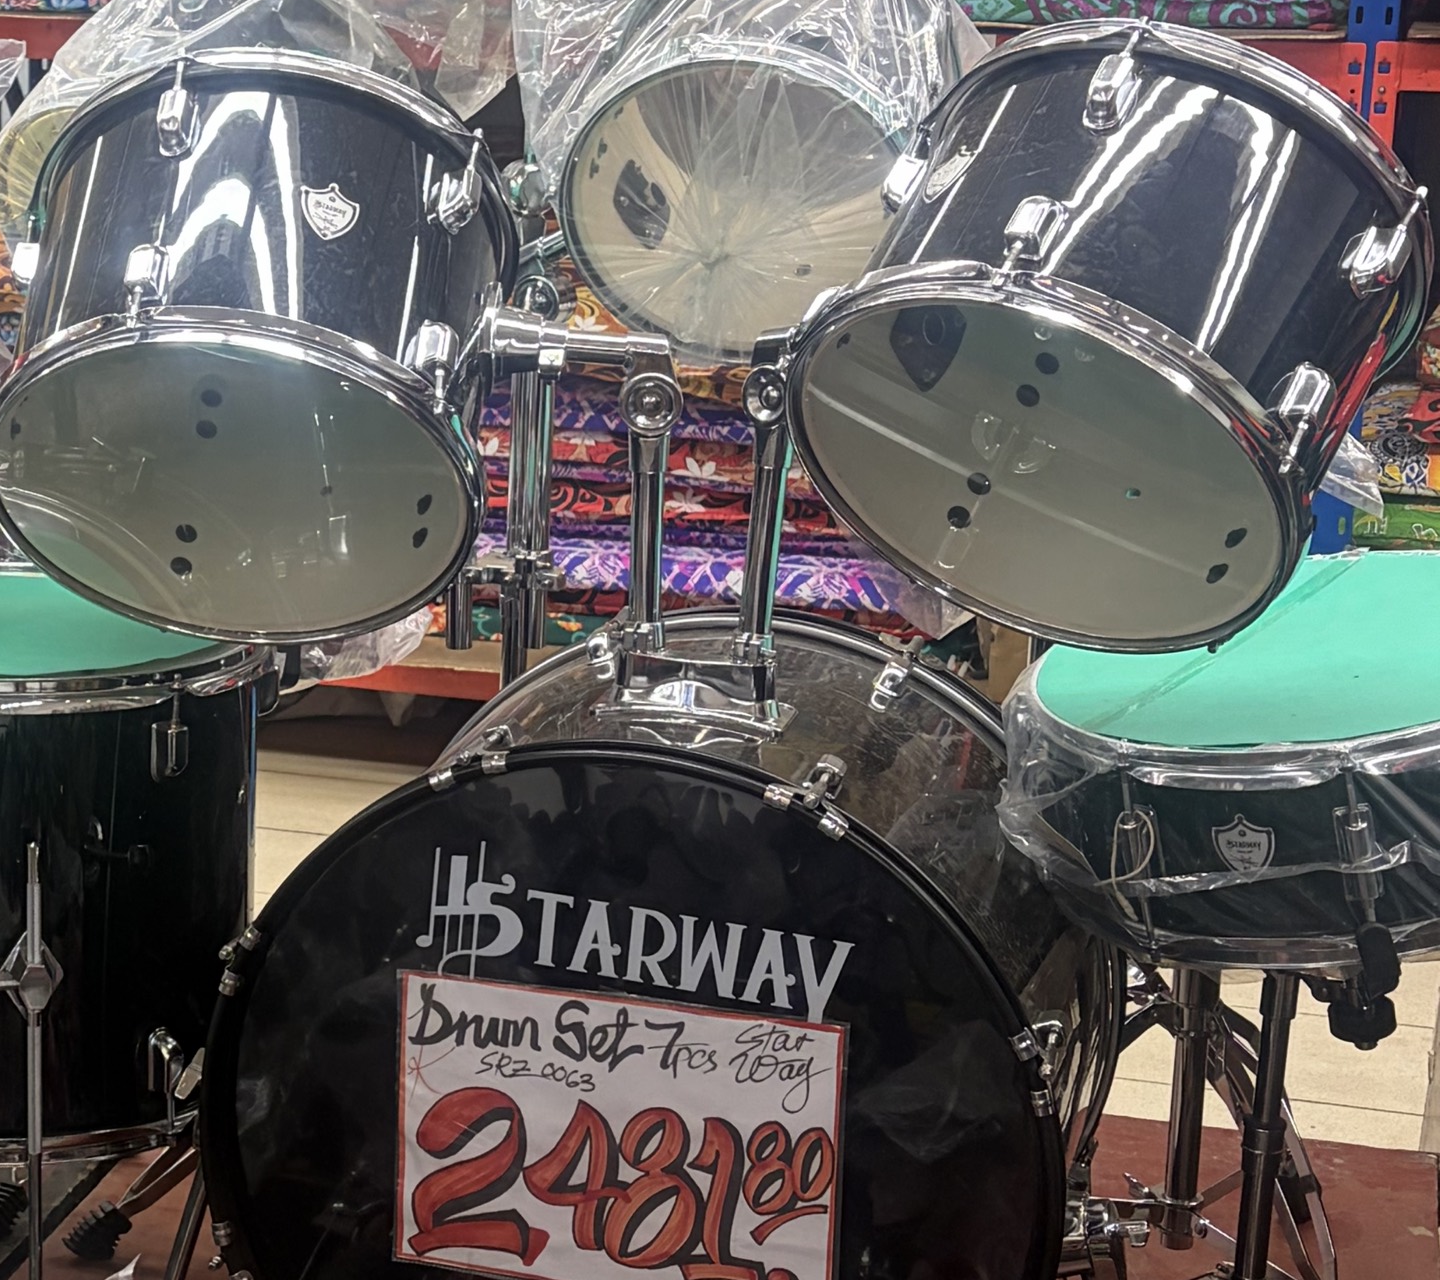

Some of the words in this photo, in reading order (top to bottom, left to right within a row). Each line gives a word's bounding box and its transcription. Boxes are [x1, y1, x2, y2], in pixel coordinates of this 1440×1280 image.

[453, 865, 855, 1023] STARWAY
[407, 982, 542, 1053] Drum
[553, 1000, 645, 1072] Set
